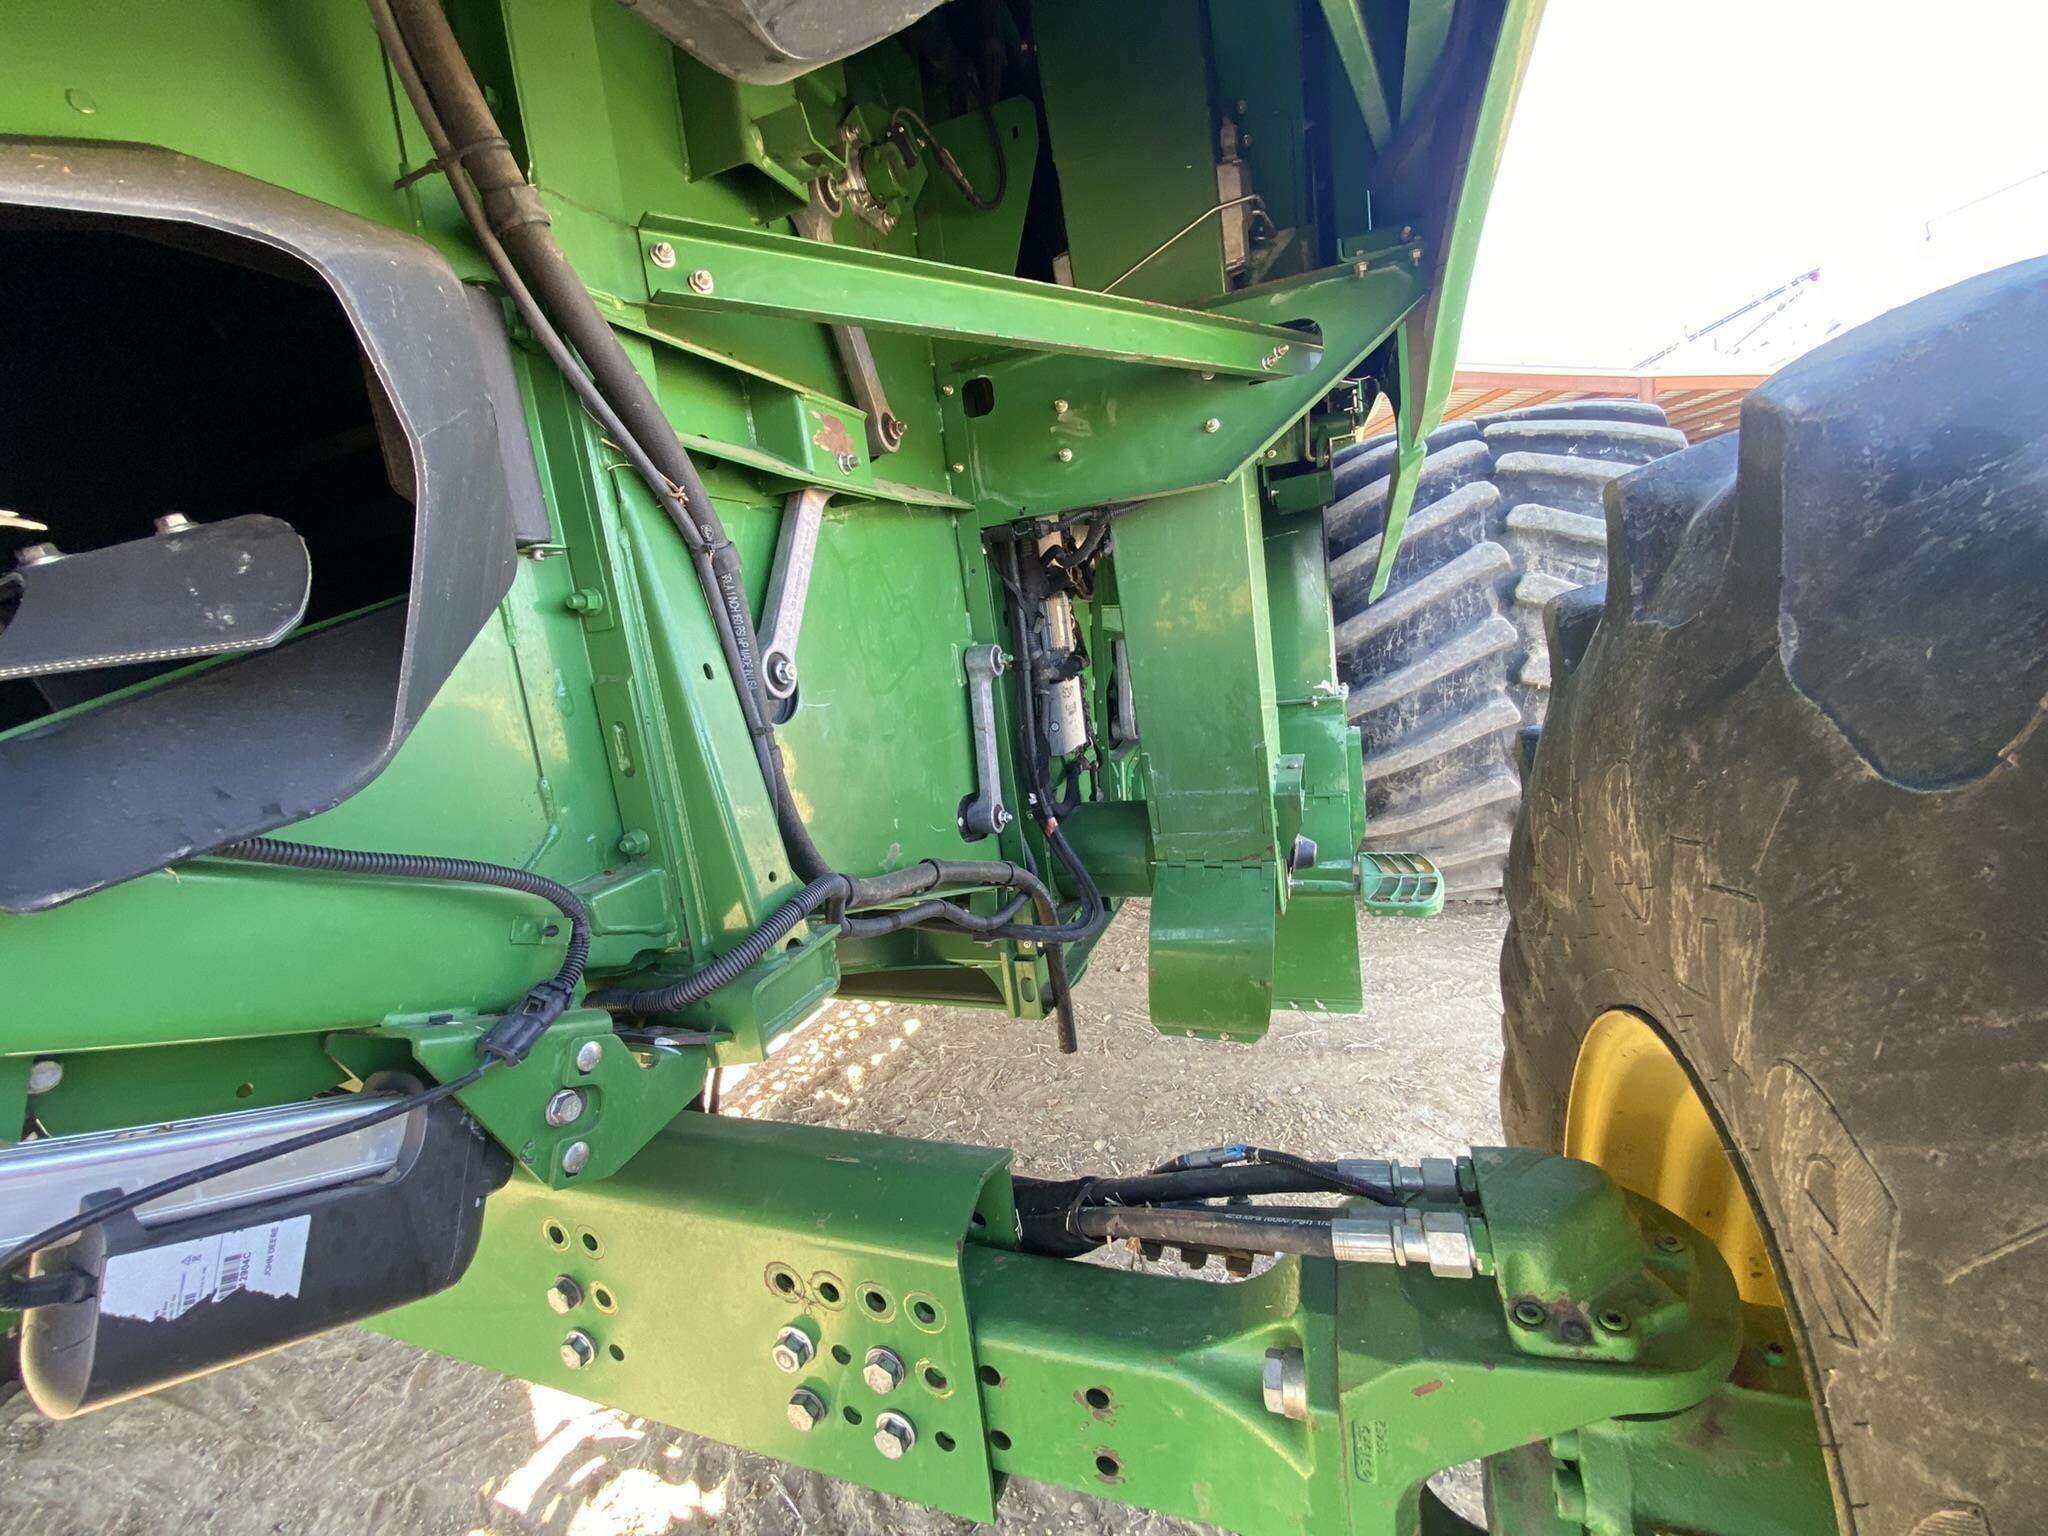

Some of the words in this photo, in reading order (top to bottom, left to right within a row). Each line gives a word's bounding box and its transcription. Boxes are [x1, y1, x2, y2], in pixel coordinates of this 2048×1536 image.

[727, 596, 742, 612] INCH
[740, 649, 754, 668] MADE
[268, 1226, 279, 1254] DEERE
[264, 1254, 274, 1276] JOHN
